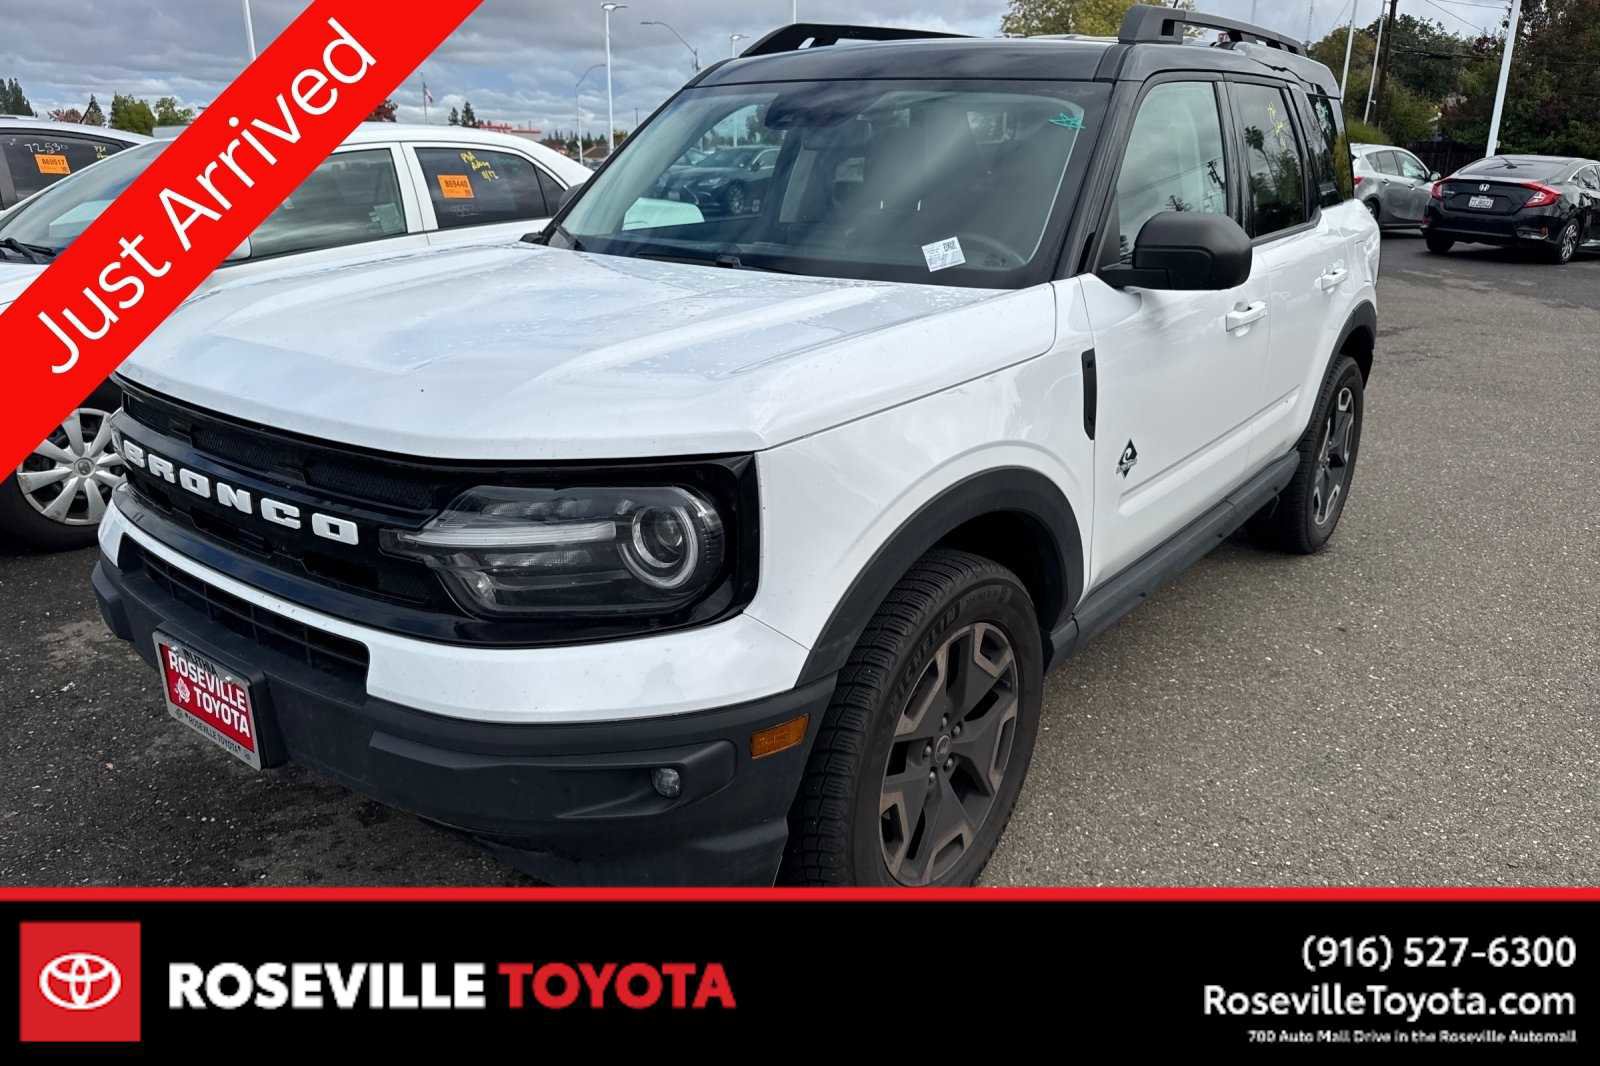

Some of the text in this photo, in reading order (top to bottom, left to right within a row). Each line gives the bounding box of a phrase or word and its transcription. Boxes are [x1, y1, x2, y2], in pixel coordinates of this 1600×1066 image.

[123, 439, 359, 545] BRONCO
[168, 650, 247, 712] ROSEVILLE
[193, 686, 251, 738] TOYOTA
